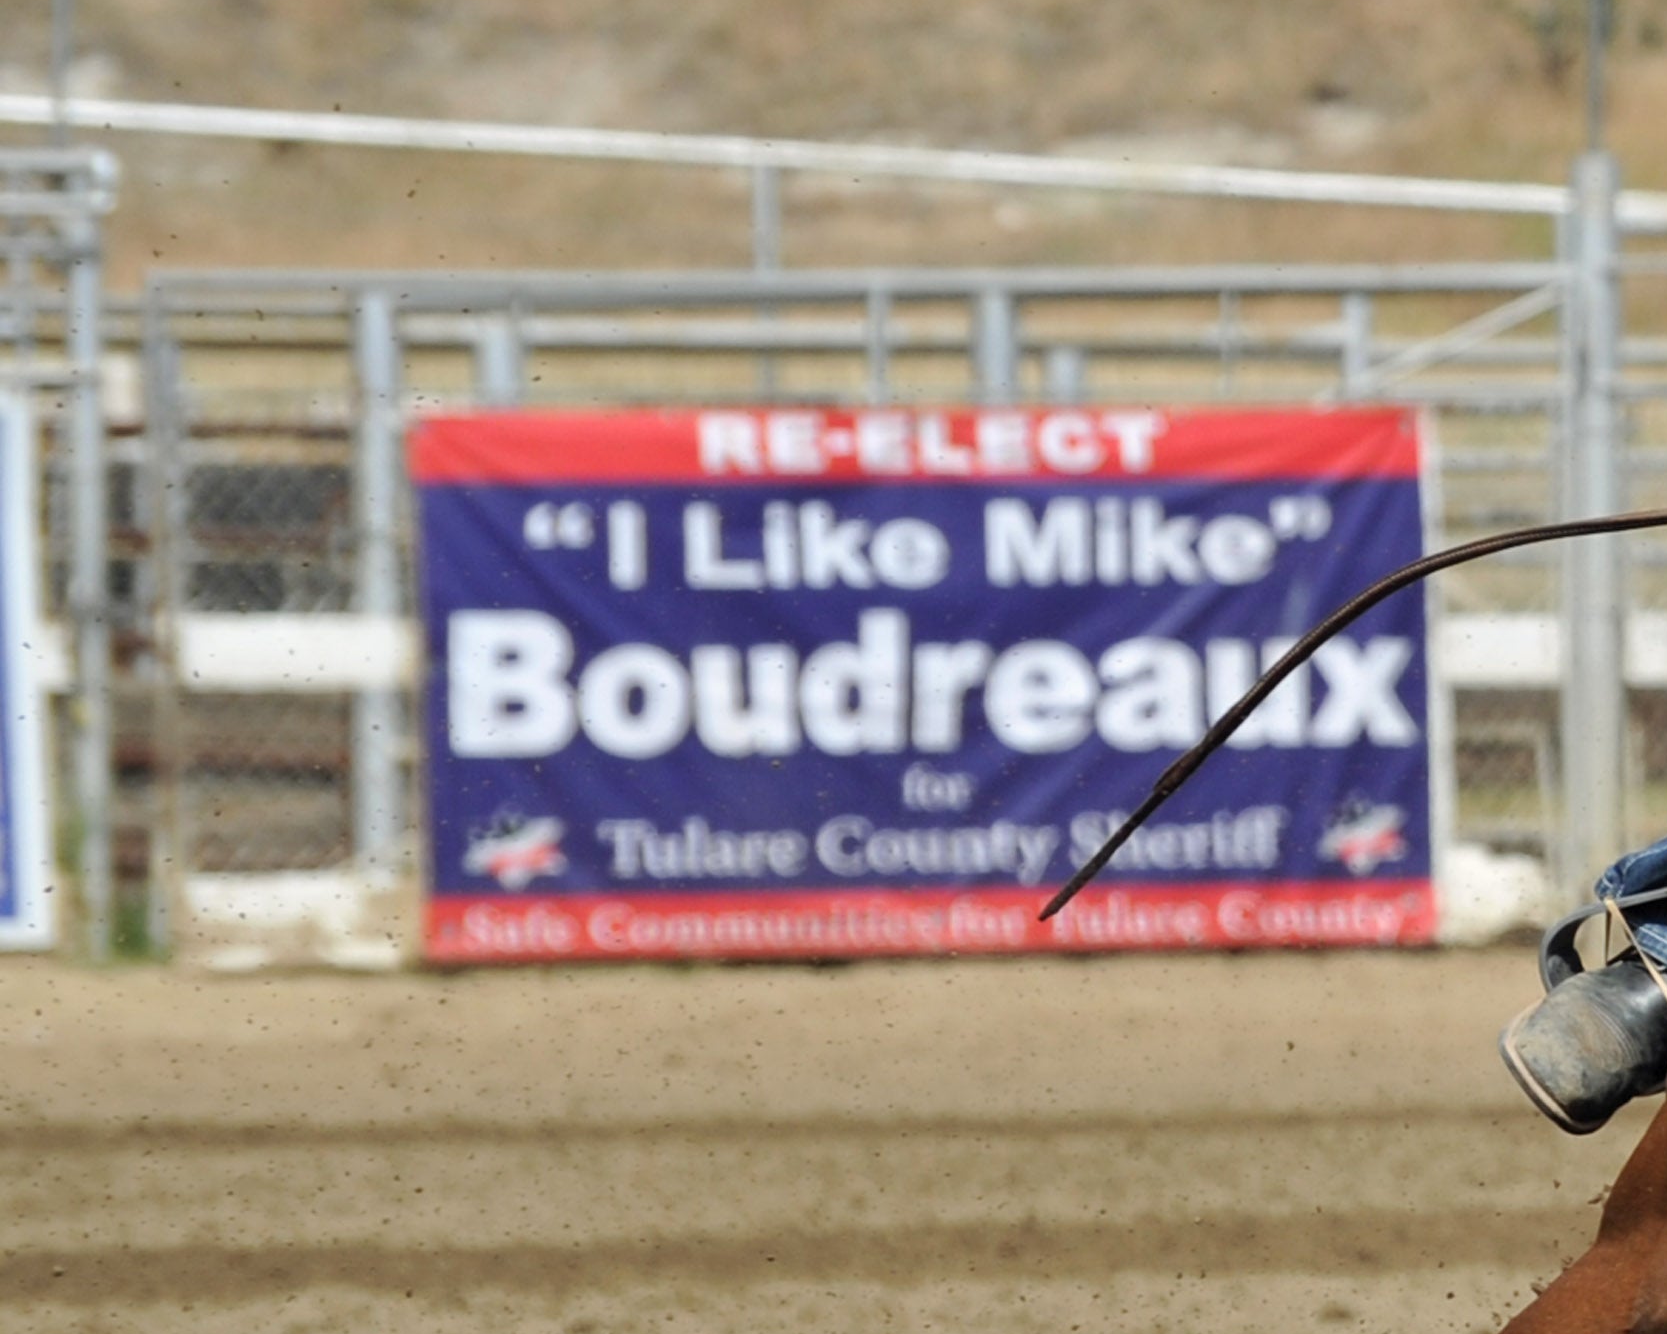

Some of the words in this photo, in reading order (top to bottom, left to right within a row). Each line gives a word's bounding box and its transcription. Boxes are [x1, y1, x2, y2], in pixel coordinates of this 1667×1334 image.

[700, 412, 1167, 475] RE-ELECT
[683, 499, 950, 591] Like
[446, 608, 1419, 759] Boudreaux
[902, 762, 975, 811] for
[597, 815, 808, 878] Tulare
[816, 813, 1058, 886] County
[1069, 805, 1288, 870] Sheriff
